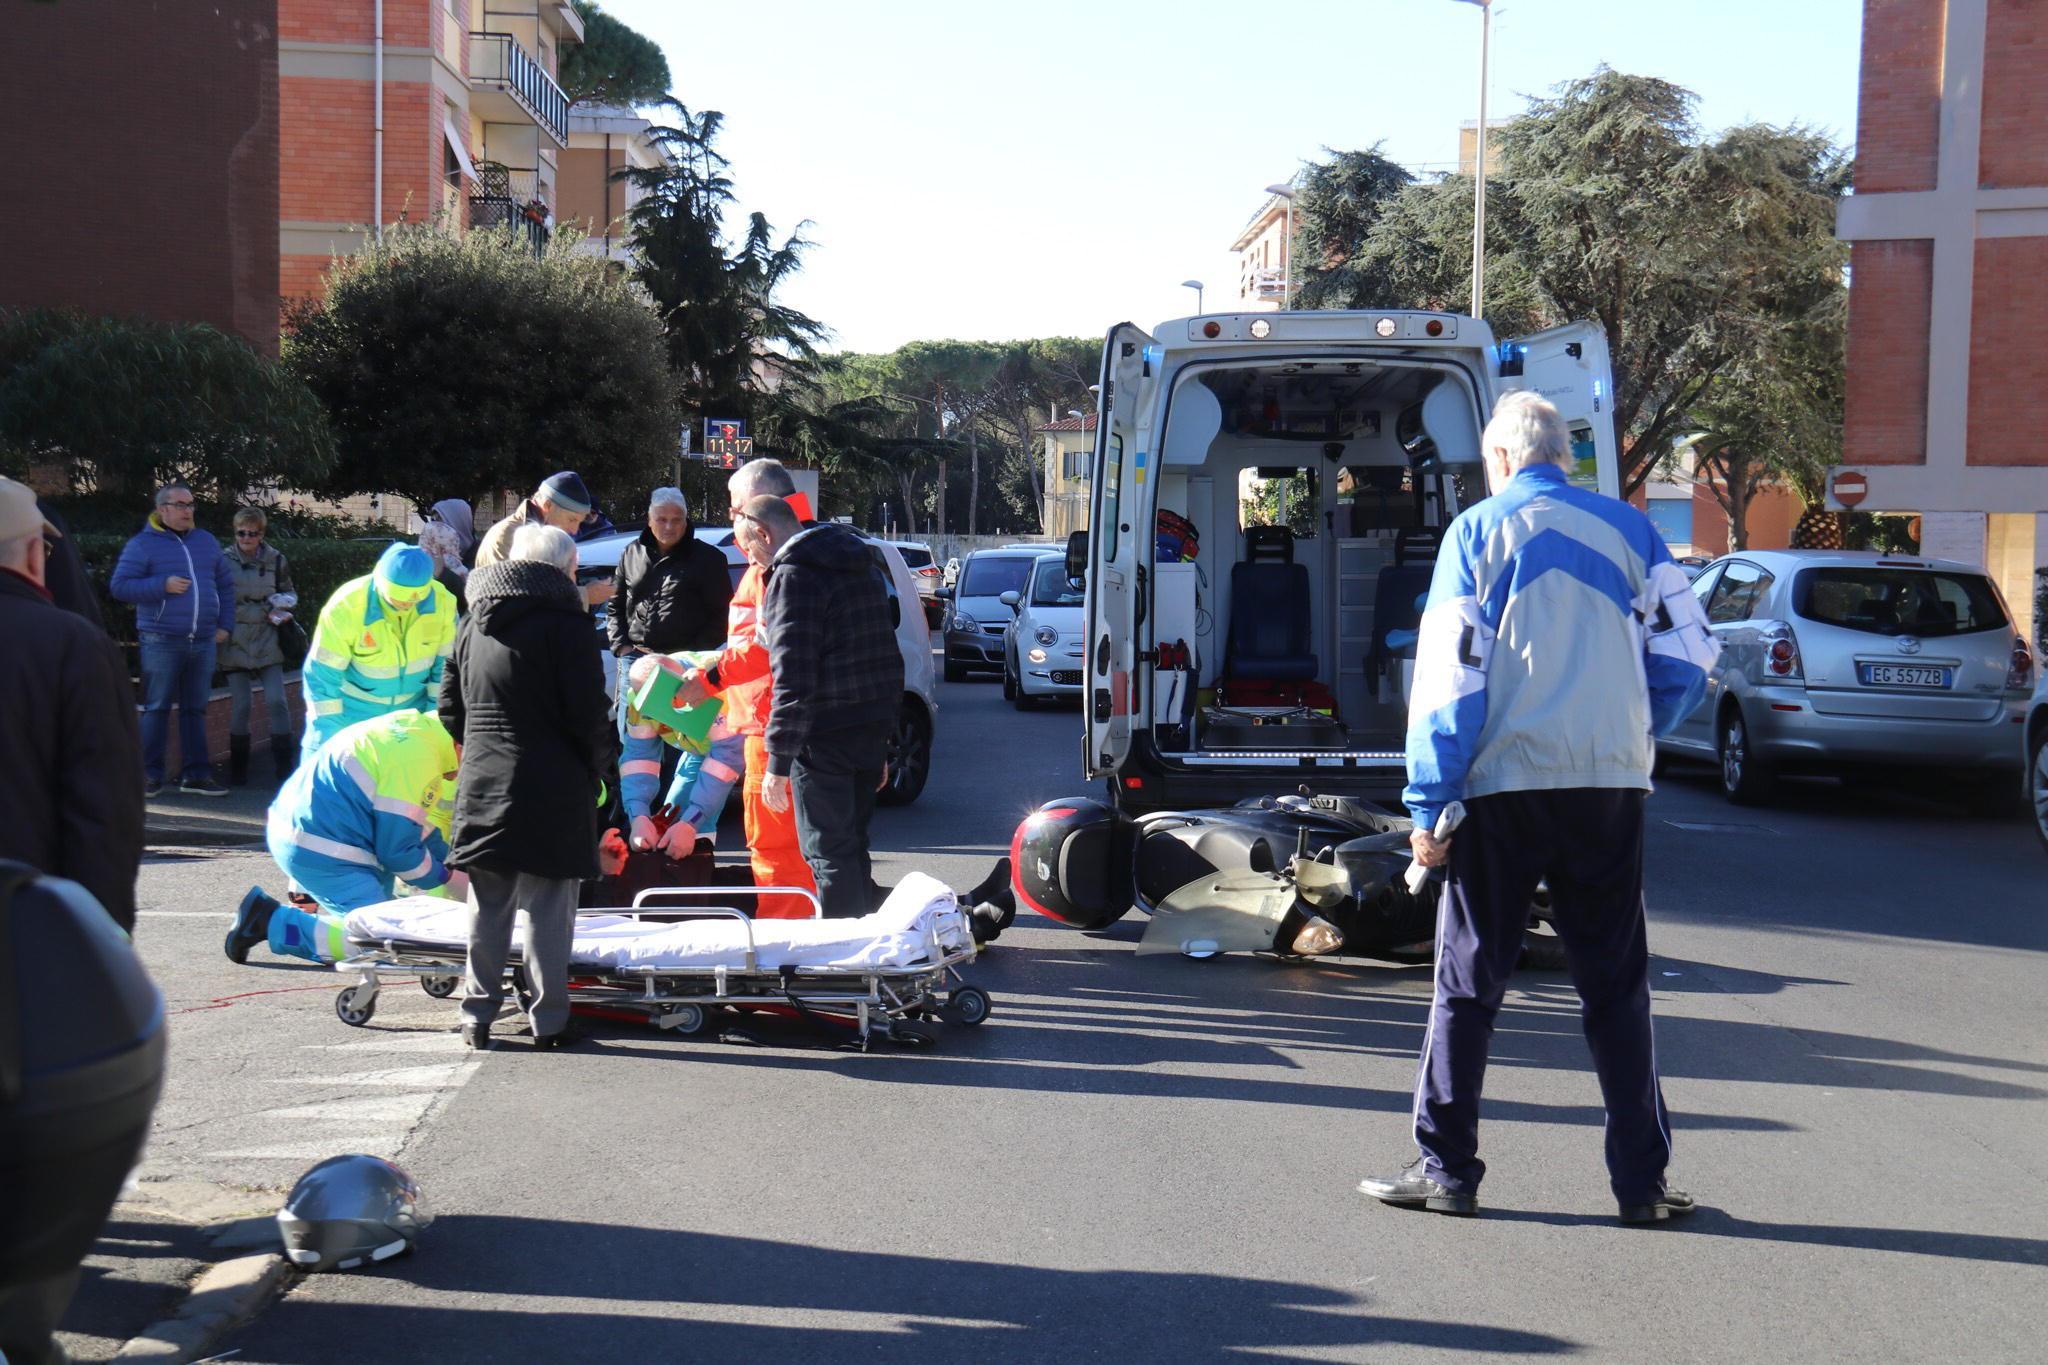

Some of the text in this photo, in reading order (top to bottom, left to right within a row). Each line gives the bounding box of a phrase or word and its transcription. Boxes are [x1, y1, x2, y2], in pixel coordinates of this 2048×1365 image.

[710, 438, 751, 453] 11:17
[1873, 667, 1891, 682] EG
[1896, 668, 1941, 685] 557ZB
